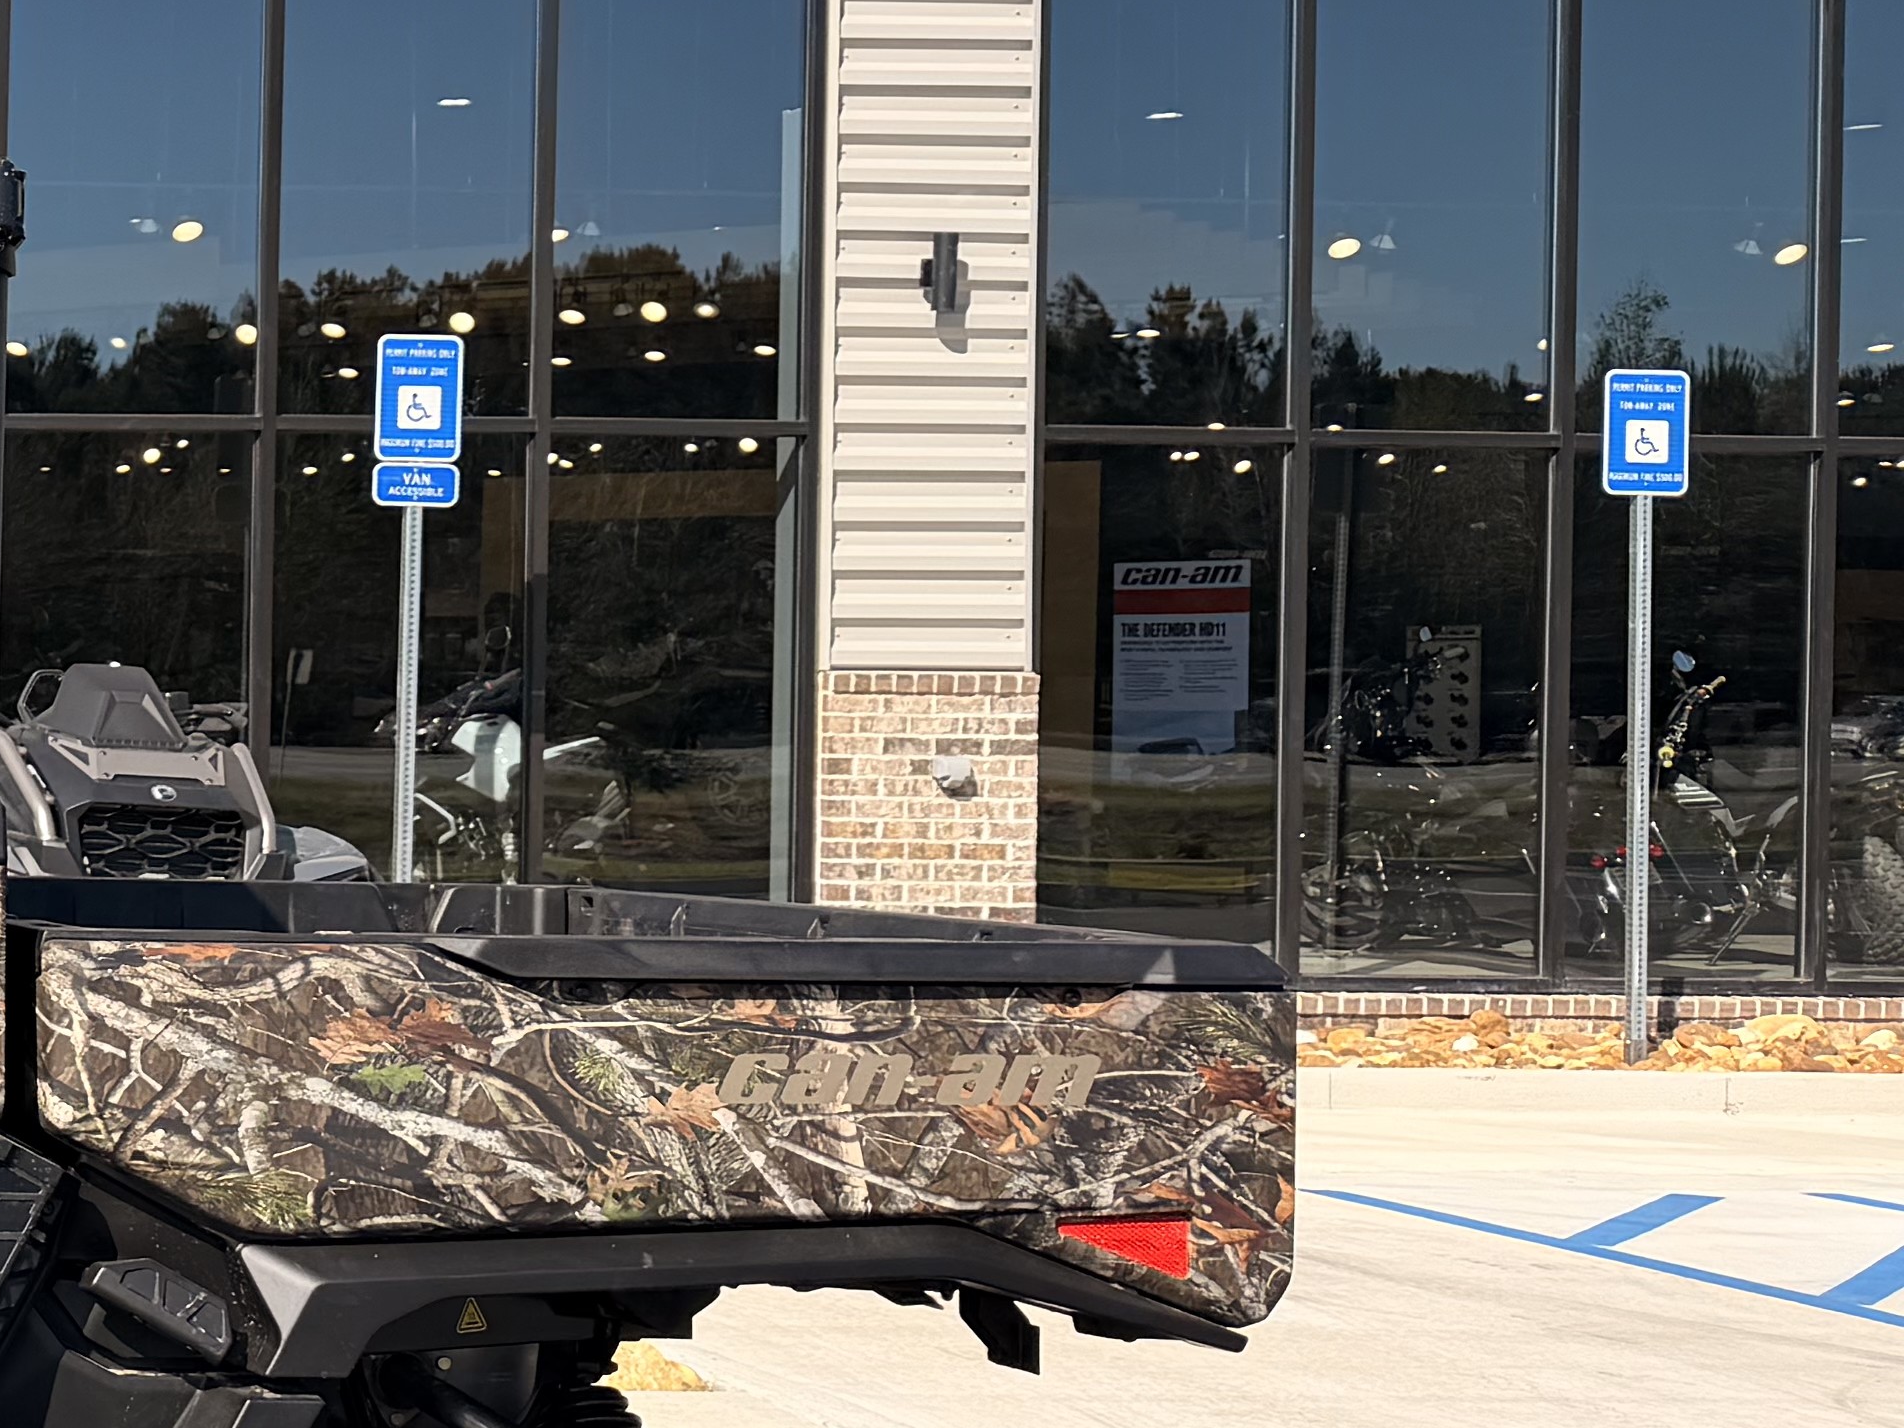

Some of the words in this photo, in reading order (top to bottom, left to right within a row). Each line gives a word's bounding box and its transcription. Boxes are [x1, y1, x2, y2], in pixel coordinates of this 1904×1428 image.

[409, 348, 437, 359] PARKING
[438, 349, 456, 359] ONLY
[392, 366, 427, 377] TOW-AWAY
[430, 367, 448, 377] ZONE
[1636, 383, 1664, 393] PARKING
[1666, 384, 1683, 393] ONLY
[1620, 401, 1654, 410] TOW-AWAY
[1658, 401, 1676, 411] ZONE
[402, 473, 431, 485] VAN
[388, 486, 444, 497] ACCESSIBLE
[1120, 564, 1243, 586] can-am
[1120, 622, 1140, 638] THE
[1143, 622, 1196, 638] DEFENDER
[1199, 622, 1226, 637] HD11
[718, 1053, 1101, 1106] can-am
